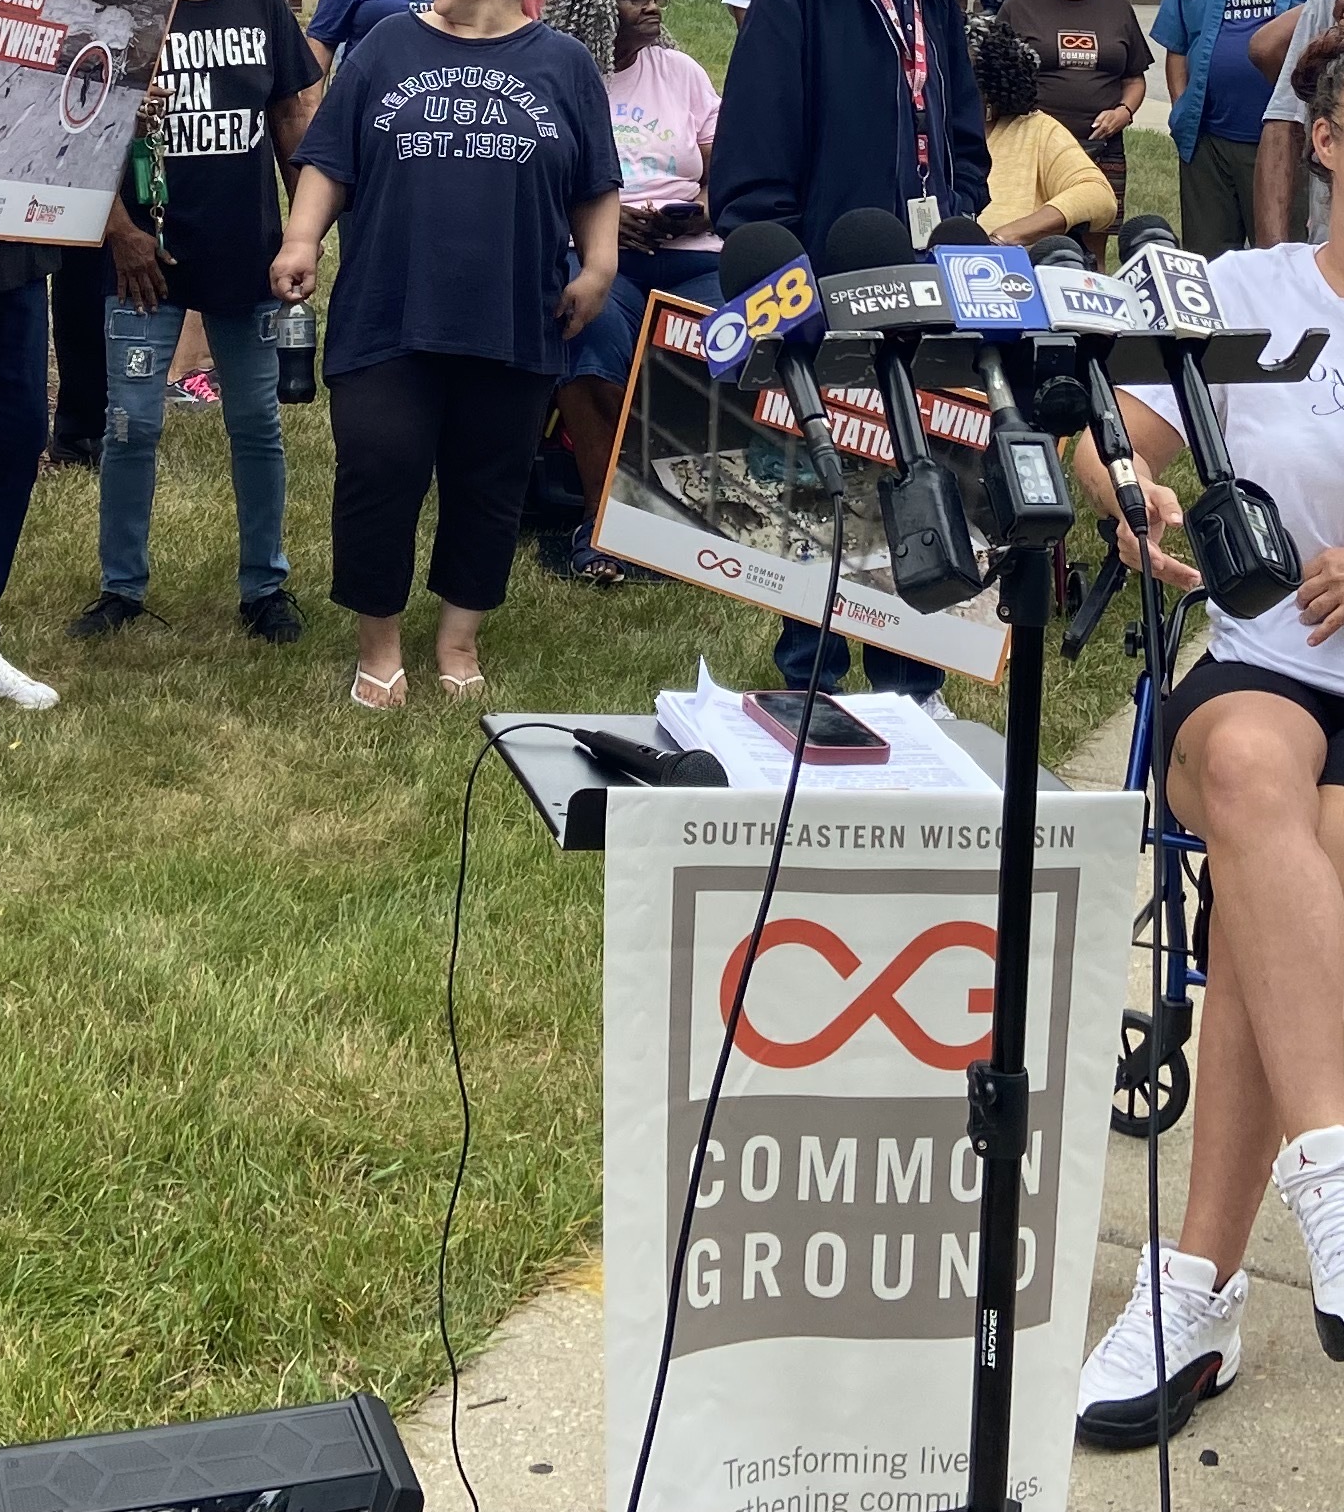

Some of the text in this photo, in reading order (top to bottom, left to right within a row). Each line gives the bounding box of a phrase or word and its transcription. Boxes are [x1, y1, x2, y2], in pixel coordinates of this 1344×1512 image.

[1224, 5, 1277, 20] GROUN
[160, 27, 267, 72] TRONGER
[153, 71, 212, 112] HAN
[423, 95, 508, 125] USA
[163, 113, 248, 154] ANCER.
[1162, 252, 1202, 278] FOX
[829, 279, 907, 305] SPECTRUM
[1000, 276, 1033, 294] abc
[1175, 278, 1211, 315] 6
[745, 267, 814, 339] 58
[850, 293, 911, 316] NEWS
[958, 302, 1018, 320] WISN
[1179, 314, 1223, 330] NEWS
[745, 572, 784, 592] GROUND
[747, 563, 786, 583] COMMON
[846, 607, 887, 629] UNITED
[847, 600, 902, 627] TENANTS
[920, 823, 1076, 850] WISCSIN
[987, 1308, 998, 1370] DRACAST
[722, 1444, 969, 1490] Transforming live
